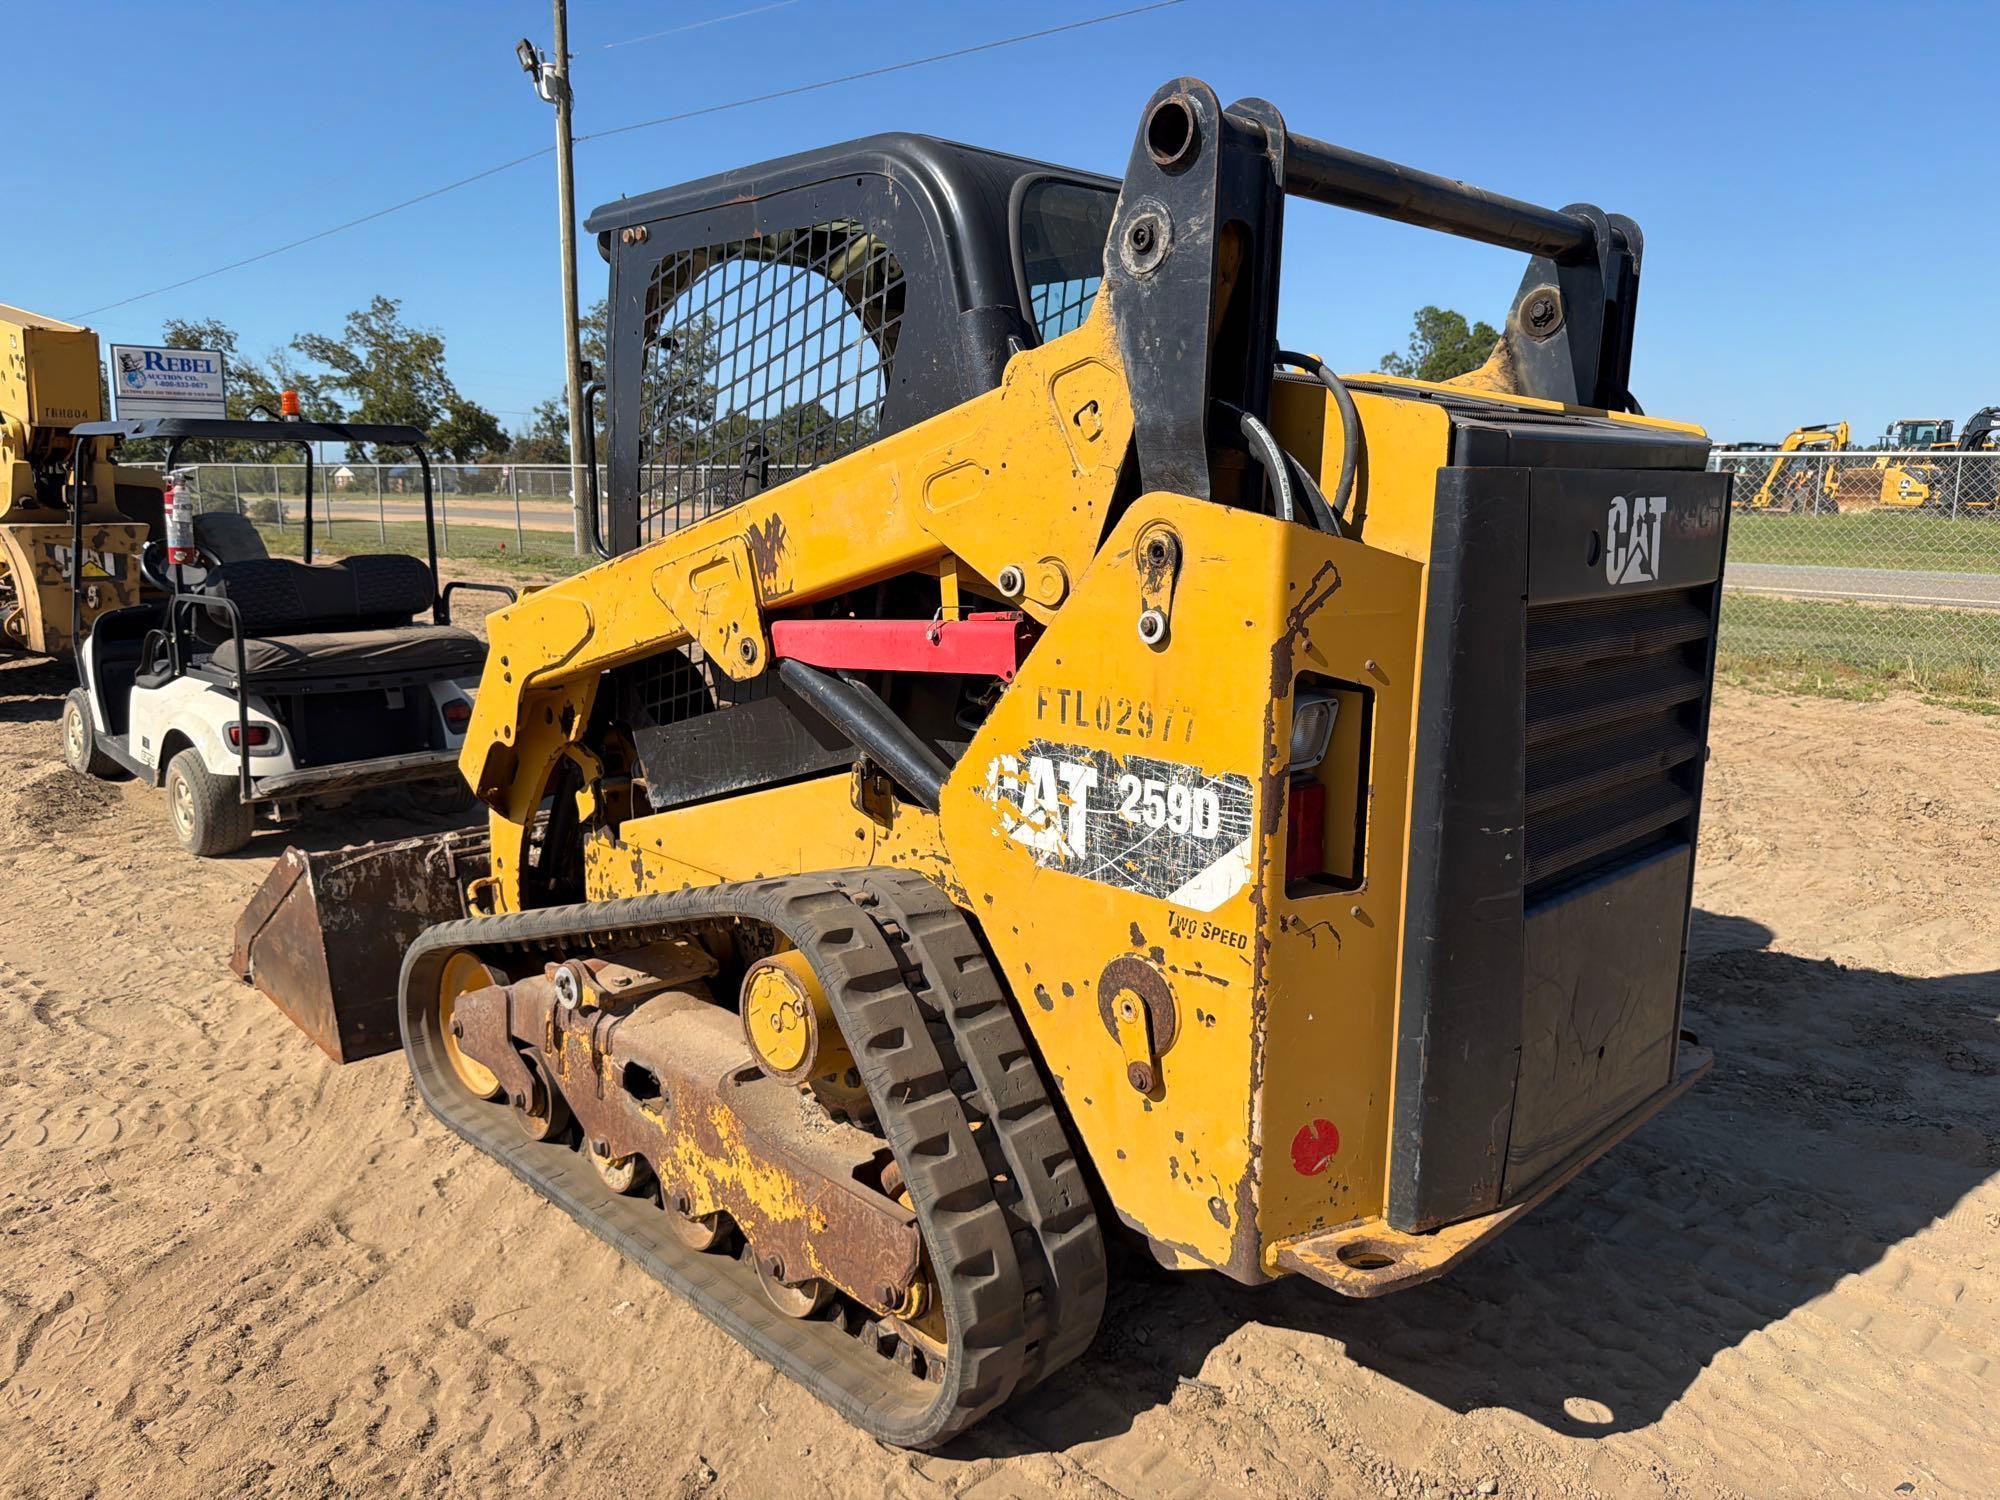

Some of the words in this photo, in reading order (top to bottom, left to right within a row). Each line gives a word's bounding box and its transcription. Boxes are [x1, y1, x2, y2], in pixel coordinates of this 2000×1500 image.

[143, 351, 217, 374] REBEL
[1605, 496, 1667, 586] CAT
[1037, 686, 1196, 743] FTL02977
[985, 753, 1098, 860] CAT
[1118, 774, 1220, 840] 259D
[1200, 921, 1248, 950] SPEED
